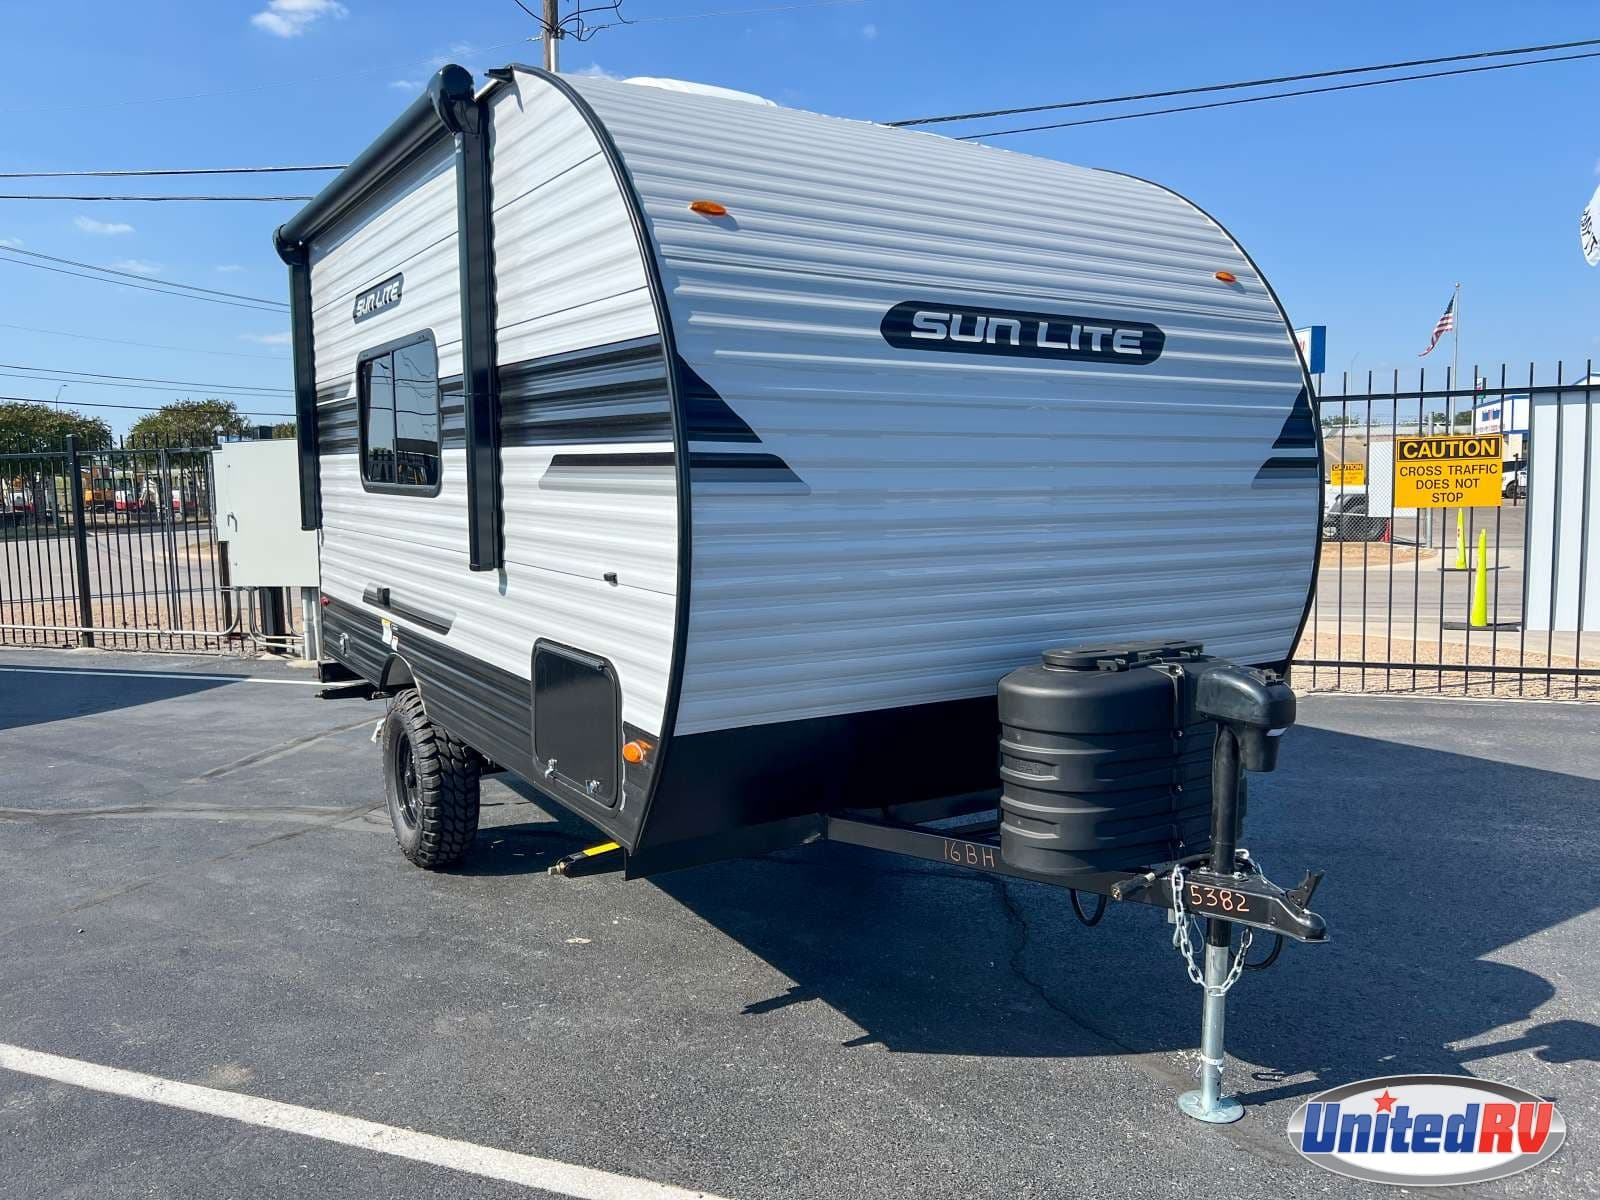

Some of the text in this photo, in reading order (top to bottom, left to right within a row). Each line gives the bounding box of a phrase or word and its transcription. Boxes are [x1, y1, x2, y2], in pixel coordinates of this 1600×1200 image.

[376, 280, 400, 308] LITE
[911, 310, 1144, 355] SUN LITE
[1403, 439, 1496, 459] CAUTION
[1400, 463, 1498, 477] CROSS TRAFFIC
[1416, 478, 1480, 490] DOES NOT
[1432, 492, 1464, 503] STOP
[944, 839, 995, 868] 16BH
[1190, 884, 1250, 912] 5382
